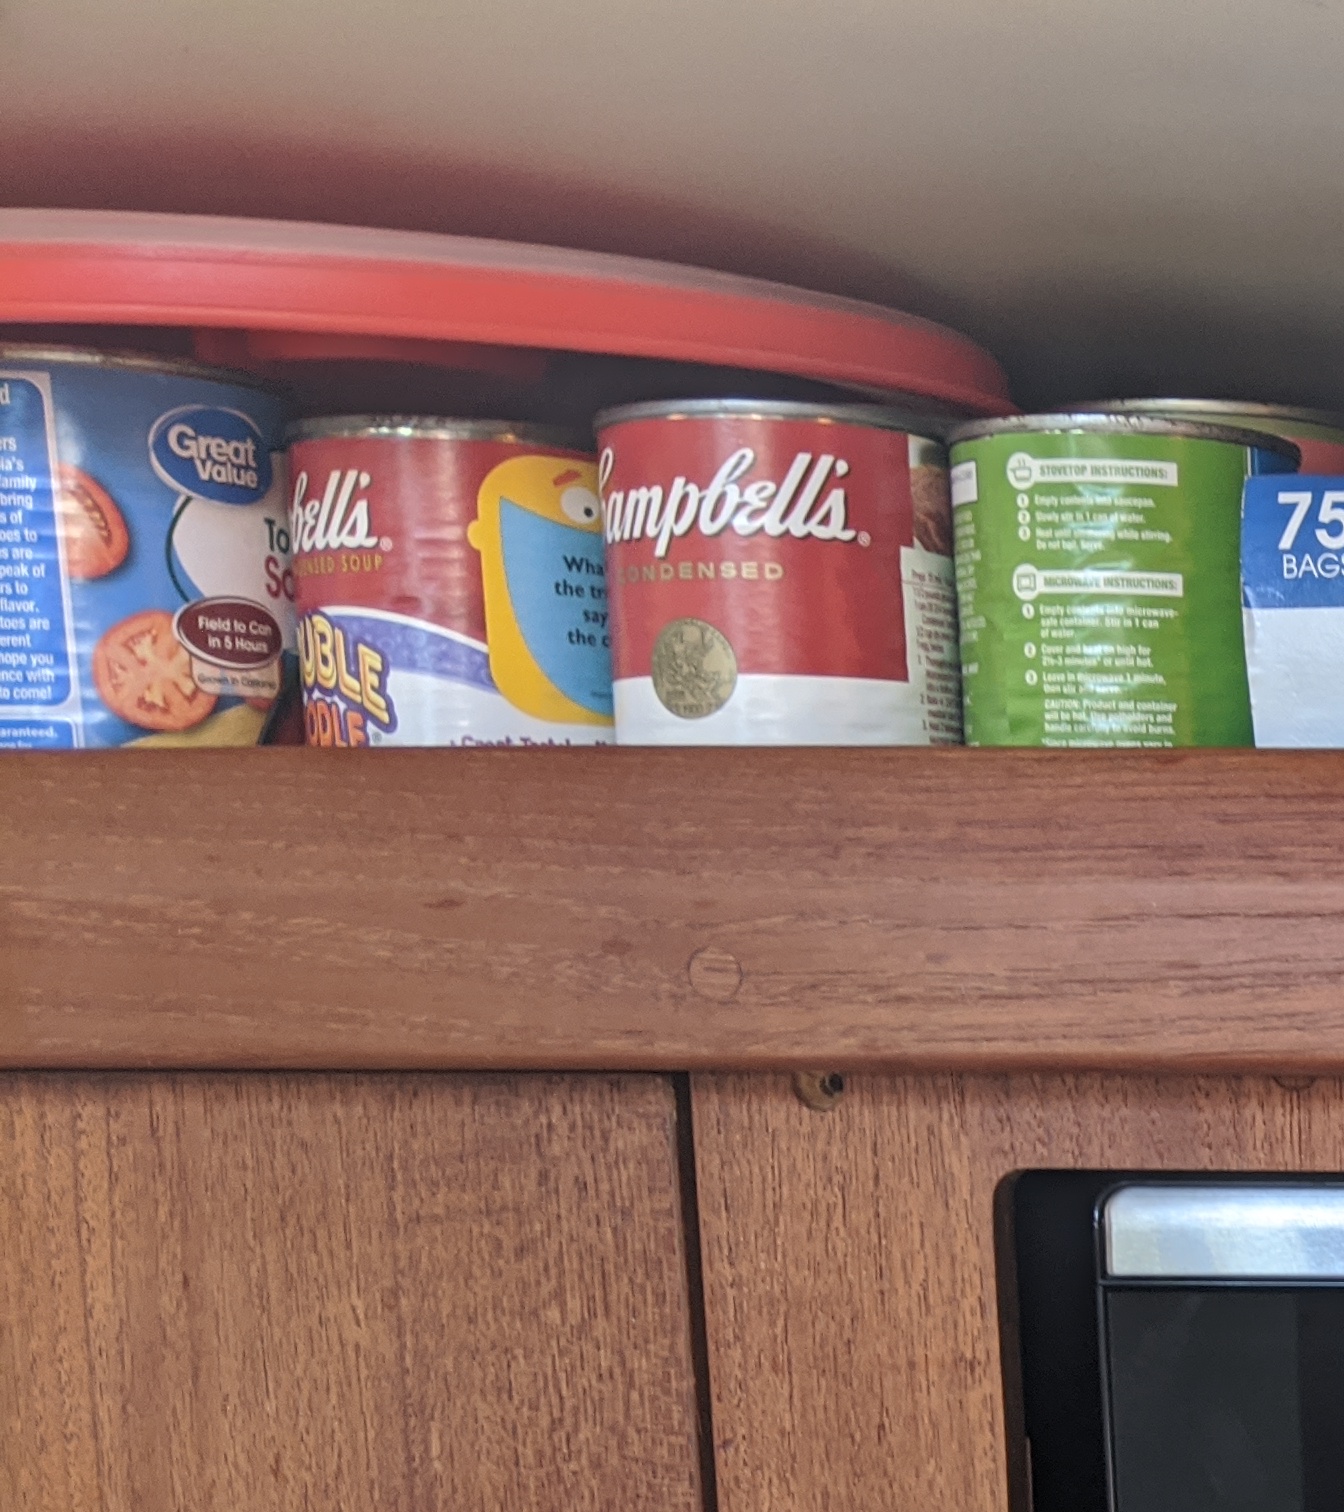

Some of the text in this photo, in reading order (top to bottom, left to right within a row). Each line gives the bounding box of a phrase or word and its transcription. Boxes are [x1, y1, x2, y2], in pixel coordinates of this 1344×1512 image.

[167, 423, 258, 468] Great
[194, 458, 258, 489] Value
[1040, 463, 1168, 479] STOVETOP INSTRUCTIONS:
[0, 477, 37, 491] amily
[341, 553, 384, 574] SOUP
[555, 579, 585, 598] the
[198, 615, 272, 636] Field to Can
[208, 633, 221, 648] in
[567, 628, 597, 647] the
